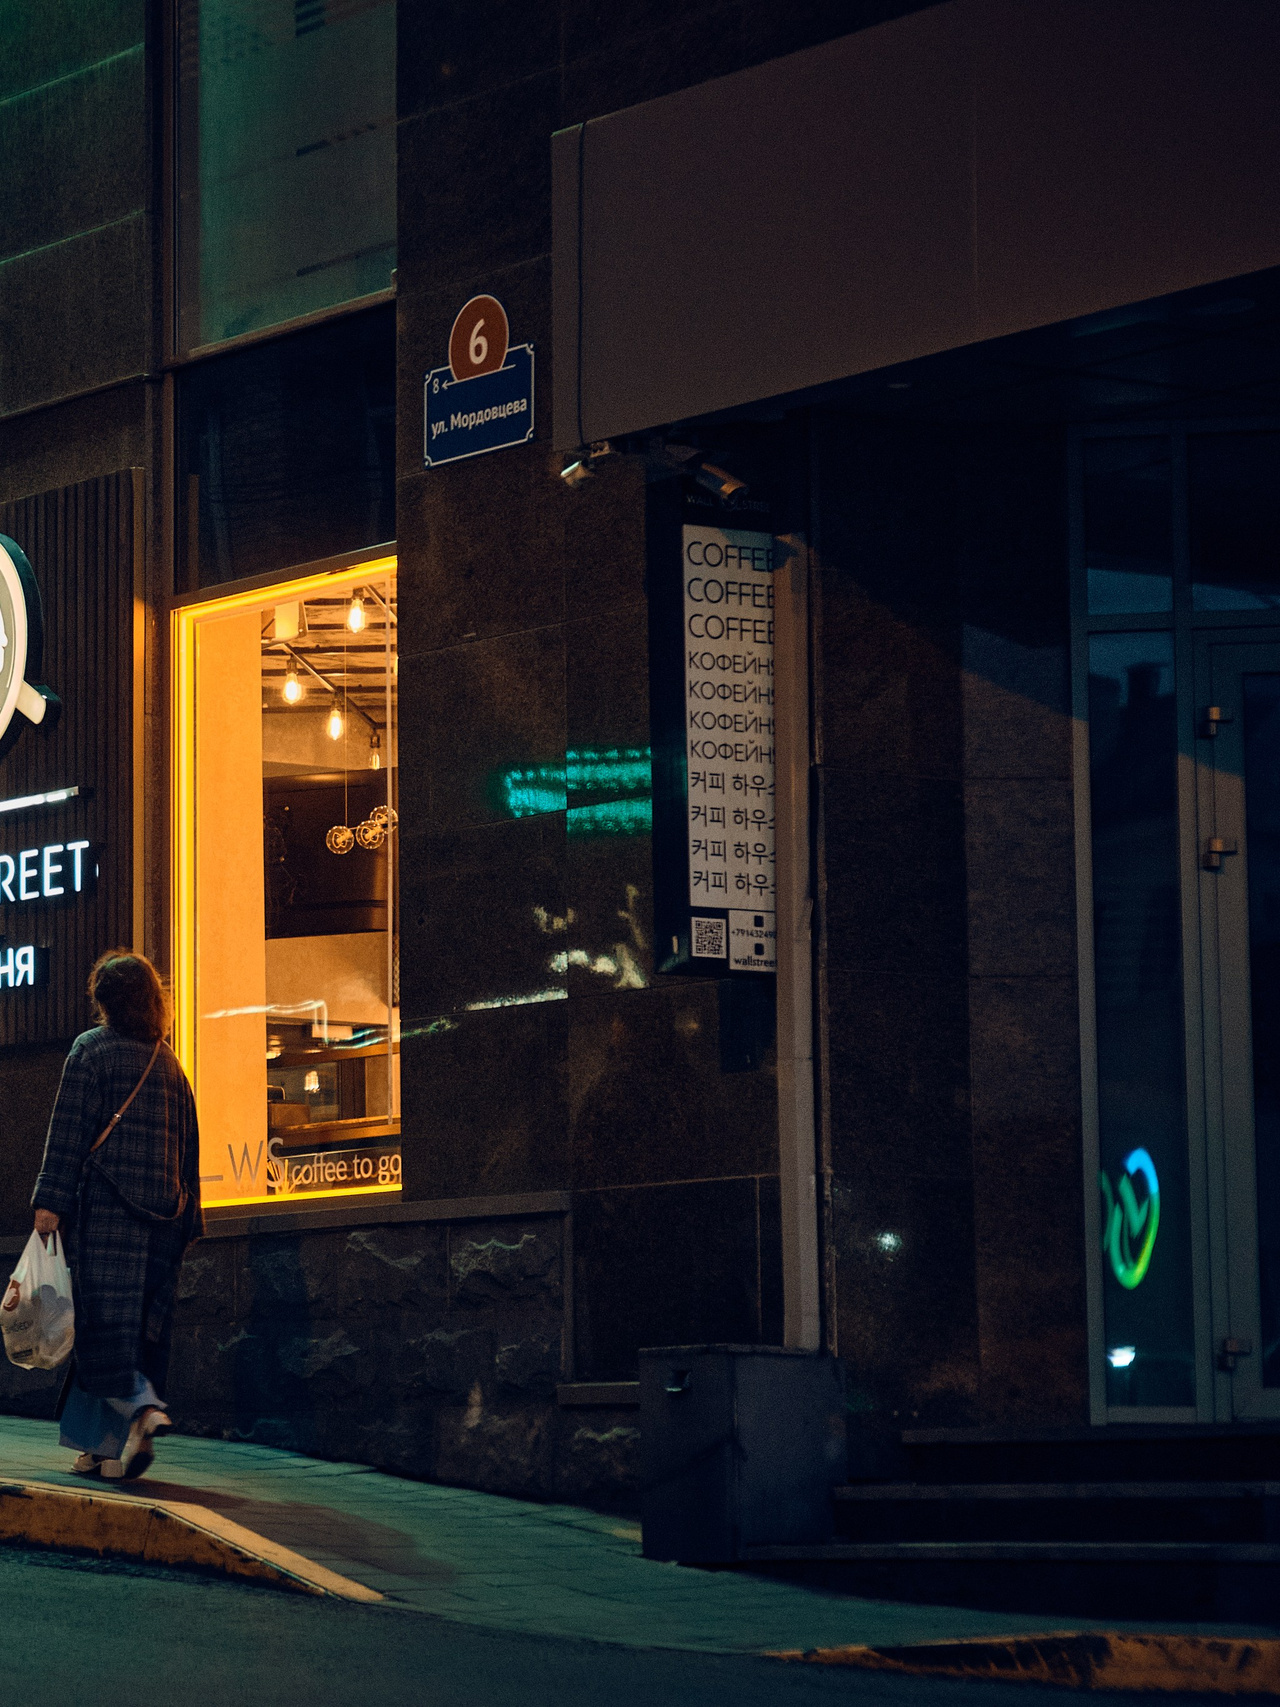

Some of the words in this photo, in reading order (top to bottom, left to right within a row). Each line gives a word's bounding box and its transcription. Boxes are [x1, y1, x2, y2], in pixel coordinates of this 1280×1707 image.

[469, 318, 488, 365] 6
[432, 378, 440, 394] 8
[431, 424, 449, 440] ул.
[450, 397, 528, 430] Мордовцева
[691, 771, 725, 794] 커피
[692, 805, 726, 828] 커피
[693, 839, 727, 862] 커피
[693, 871, 727, 894] 커피
[292, 1153, 348, 1186] coffee
[352, 1154, 373, 1179] to
[378, 1153, 402, 1184] go
